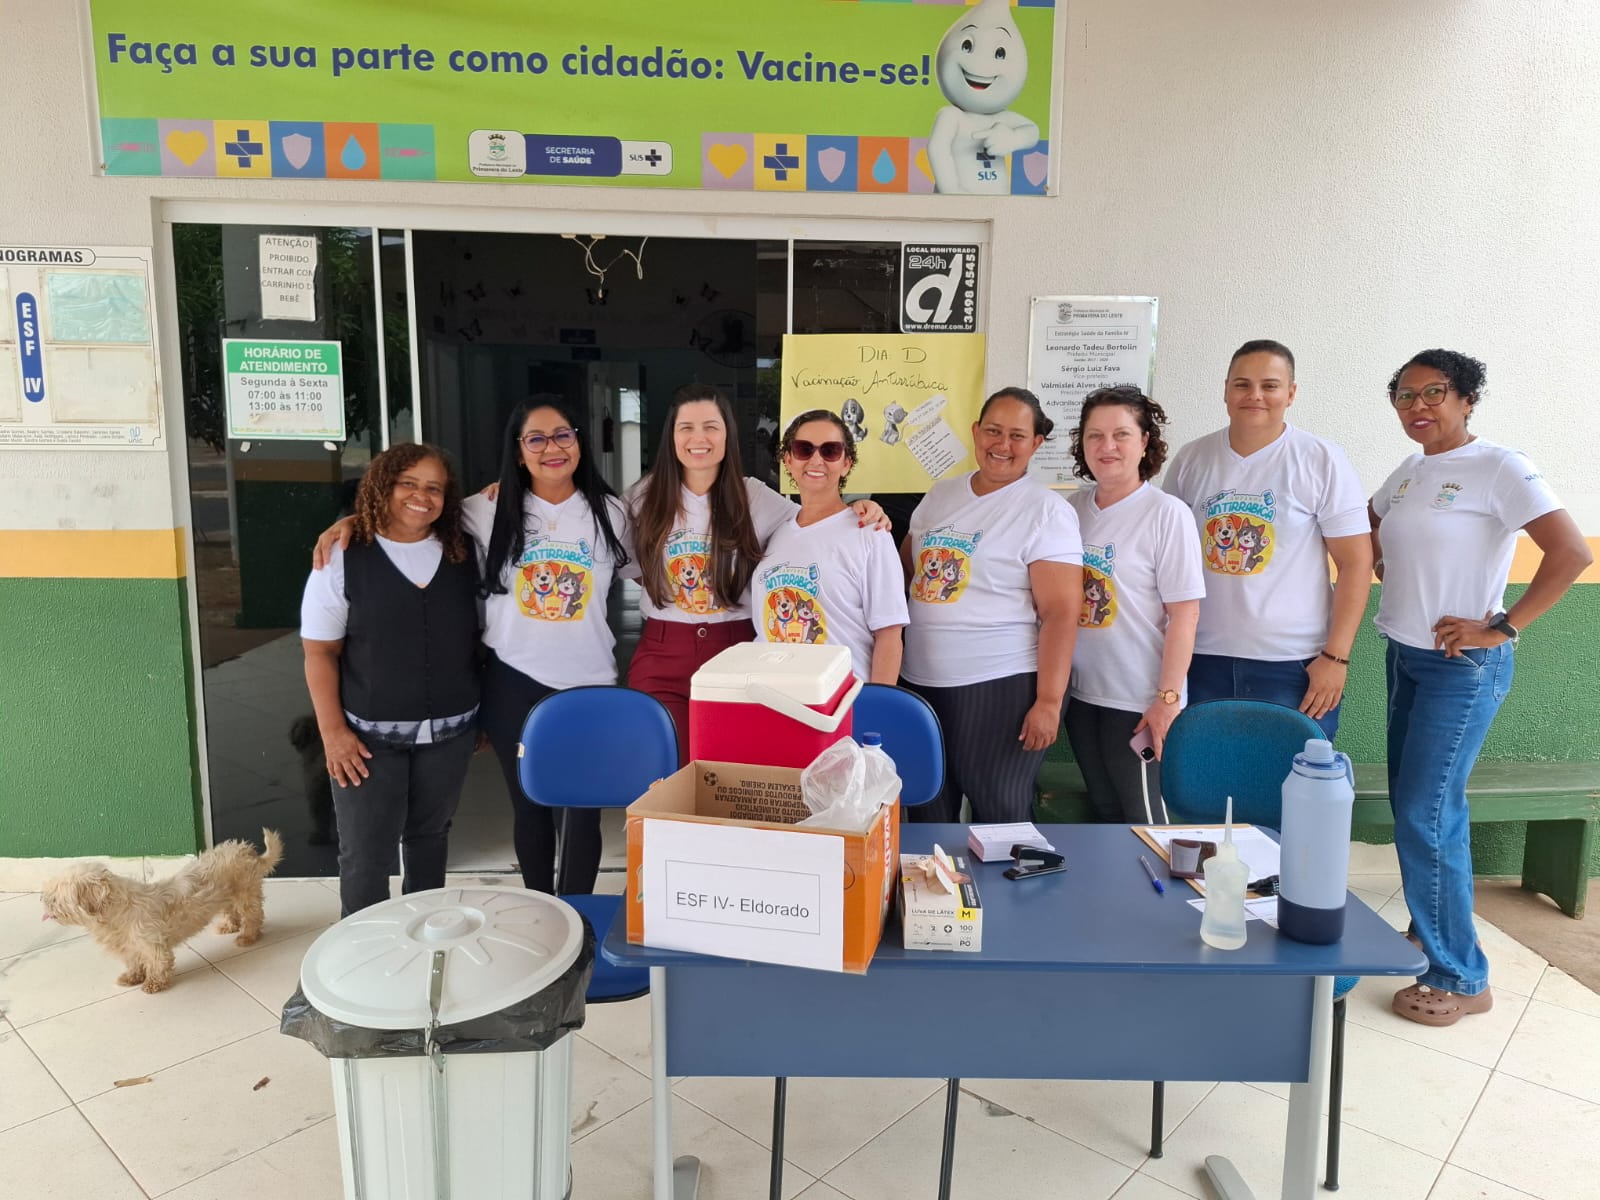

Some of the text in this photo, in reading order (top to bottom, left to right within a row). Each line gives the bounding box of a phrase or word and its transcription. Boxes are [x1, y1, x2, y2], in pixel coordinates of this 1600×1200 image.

[107, 33, 931, 86] Faça a sua parte como cidadão: Vacine-se!
[545, 146, 595, 155] SECRETARIA
[549, 155, 592, 165] DE SAÚDE
[977, 170, 997, 181] SUS
[266, 237, 313, 248] ATENÇÃO!
[269, 253, 309, 263] PROIBIDO
[908, 255, 947, 269] 24h
[262, 267, 294, 276] ENTRAR
[261, 280, 305, 290] CARRINHO
[963, 254, 976, 323] 3498 4545
[279, 294, 300, 302] BEBÊ
[244, 346, 322, 359] HORÁRIO DE
[903, 347, 927, 363] D
[239, 361, 328, 373] ATENDIMENTO
[1061, 365, 1085, 373] Sérgio
[240, 377, 328, 388] Segunda à Sexta
[791, 368, 861, 388] Vacinação
[25, 377, 41, 393] IV
[248, 390, 322, 401] 07:00 às 11:00
[249, 402, 323, 412] 13:00 às 17:00
[767, 783, 796, 792] EXALEM
[765, 791, 802, 801] PRODUTOS
[676, 891, 708, 907] ESF
[740, 898, 810, 918] Eldorado
